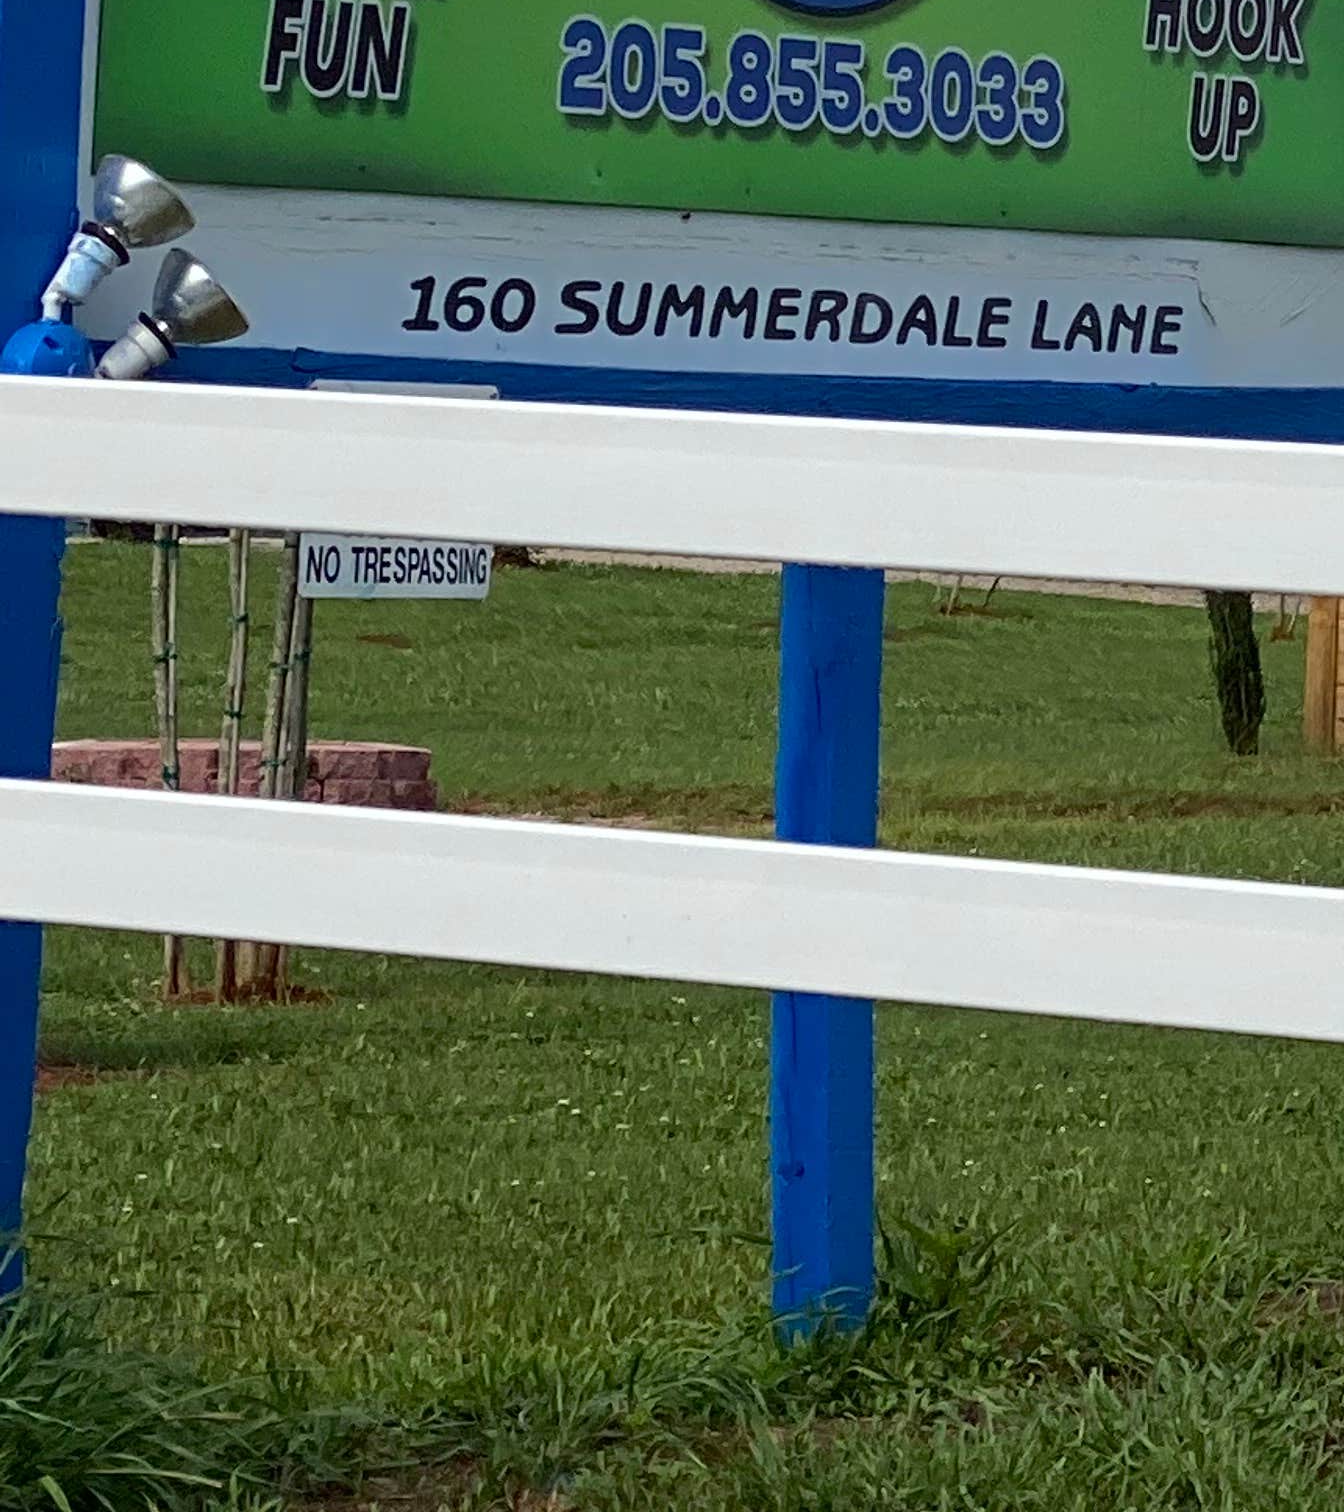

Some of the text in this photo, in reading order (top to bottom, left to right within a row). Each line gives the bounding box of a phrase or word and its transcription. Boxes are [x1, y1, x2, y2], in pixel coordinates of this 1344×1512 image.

[556, 14, 1065, 148] 205.855.3033
[1187, 71, 1260, 163] UP
[400, 274, 1185, 356] 160 SUMMERDALE LANE
[305, 545, 487, 585] NO TRESPASSING
